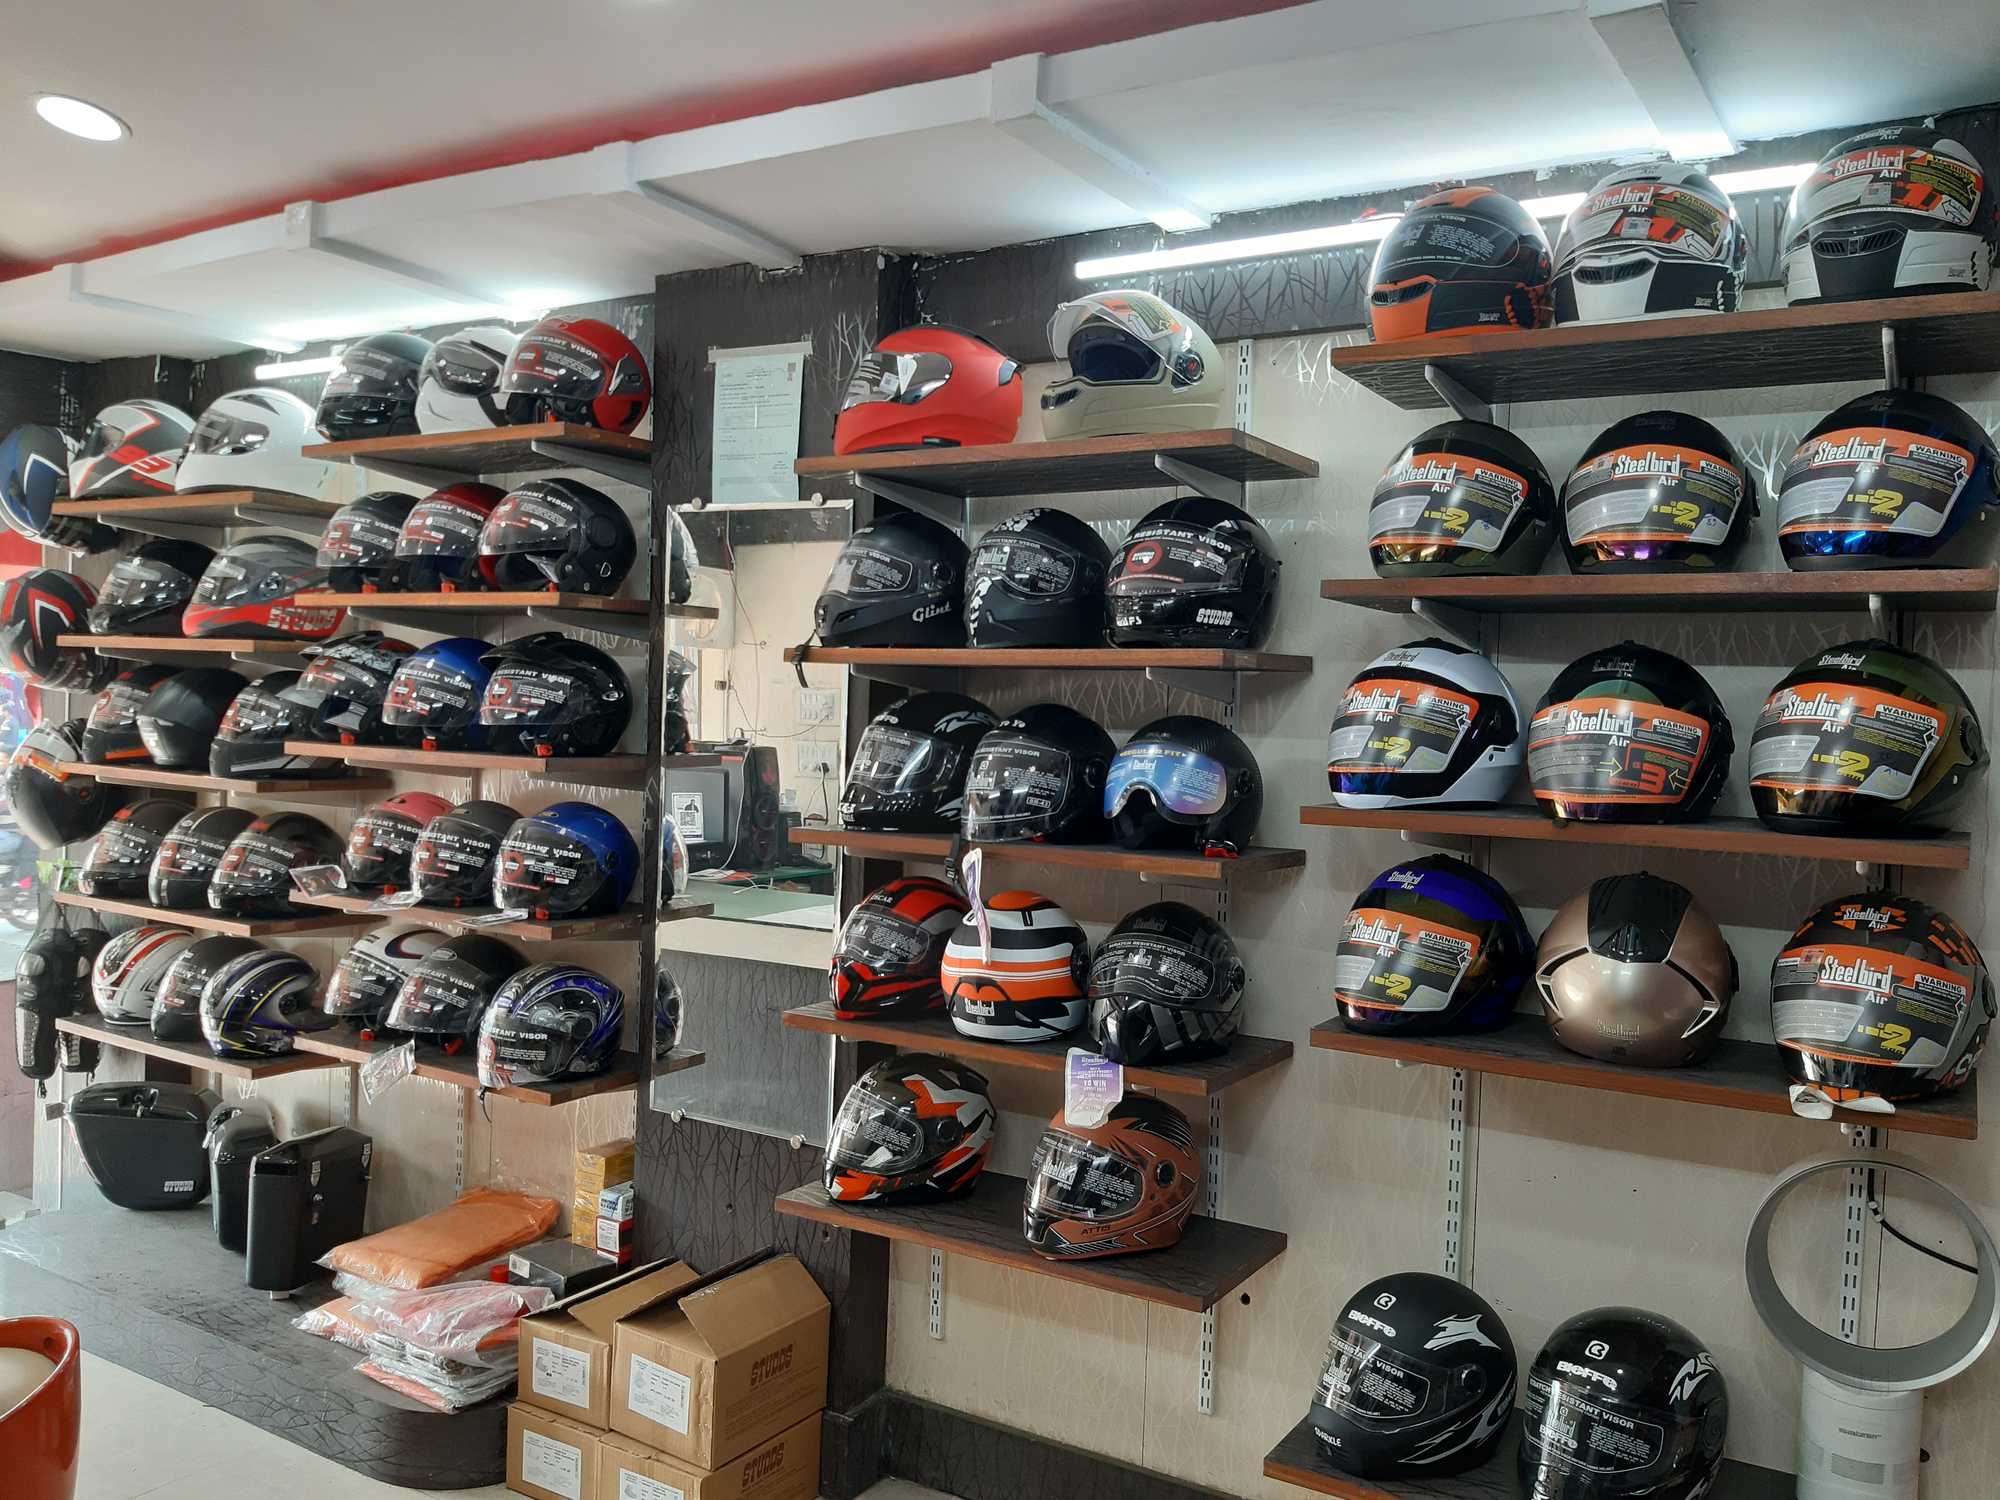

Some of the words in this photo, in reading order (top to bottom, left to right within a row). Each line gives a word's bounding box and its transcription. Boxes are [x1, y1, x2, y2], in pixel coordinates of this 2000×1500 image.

[1834, 150, 1905, 176] Steelbird
[1879, 170, 1902, 178] Air
[1592, 187, 1655, 213] Steelbird
[571, 342, 598, 359] VISOR
[1814, 437, 1887, 463] Steelbird
[1915, 445, 1962, 463] WARNING
[1615, 452, 1681, 475] Steelbird
[1400, 460, 1457, 484] Steelbird
[1480, 469, 1520, 487] WARNING
[1431, 484, 1451, 493] Air
[1658, 476, 1679, 486] Air
[547, 495, 573, 511] VISOR
[457, 505, 484, 521] VISOR
[1134, 529, 1194, 539] RESISTANT
[1198, 535, 1232, 552] VISOR
[912, 601, 952, 622] Glint
[1196, 608, 1233, 626] STUDDS
[1818, 653, 1866, 666] Steelbird
[444, 676, 472, 690] VISOR
[541, 673, 571, 685] VISOR
[1350, 688, 1401, 712] Steelbird
[1376, 712, 1393, 722] Air
[1567, 709, 1633, 733] Steelbird
[1882, 706, 1933, 725] WARNING
[1658, 719, 1699, 734] WARNING
[1821, 722, 1845, 733] Air
[1608, 735, 1630, 747] Air
[463, 838, 491, 849] VISOR
[553, 848, 582, 859] VISOR
[1388, 871, 1424, 884] Steelbird
[1842, 907, 1891, 922] Steelbird
[1352, 917, 1403, 947] Steelbird
[1869, 920, 1888, 929] Air
[1424, 932, 1466, 948] WARNING
[1376, 946, 1394, 957] Air
[1822, 955, 1893, 993] Steelbird
[449, 977, 475, 990] VISOR
[1920, 975, 1964, 993] WARNING
[1865, 991, 1888, 1004] Air
[519, 1031, 548, 1041] VISOR
[751, 1344, 793, 1386] STUDDS
[1336, 1340, 1375, 1364] RESISTAT
[1376, 1360, 1404, 1378] VISOR
[1602, 1411, 1635, 1430] VISOR
[742, 1442, 785, 1488] STUDDS
